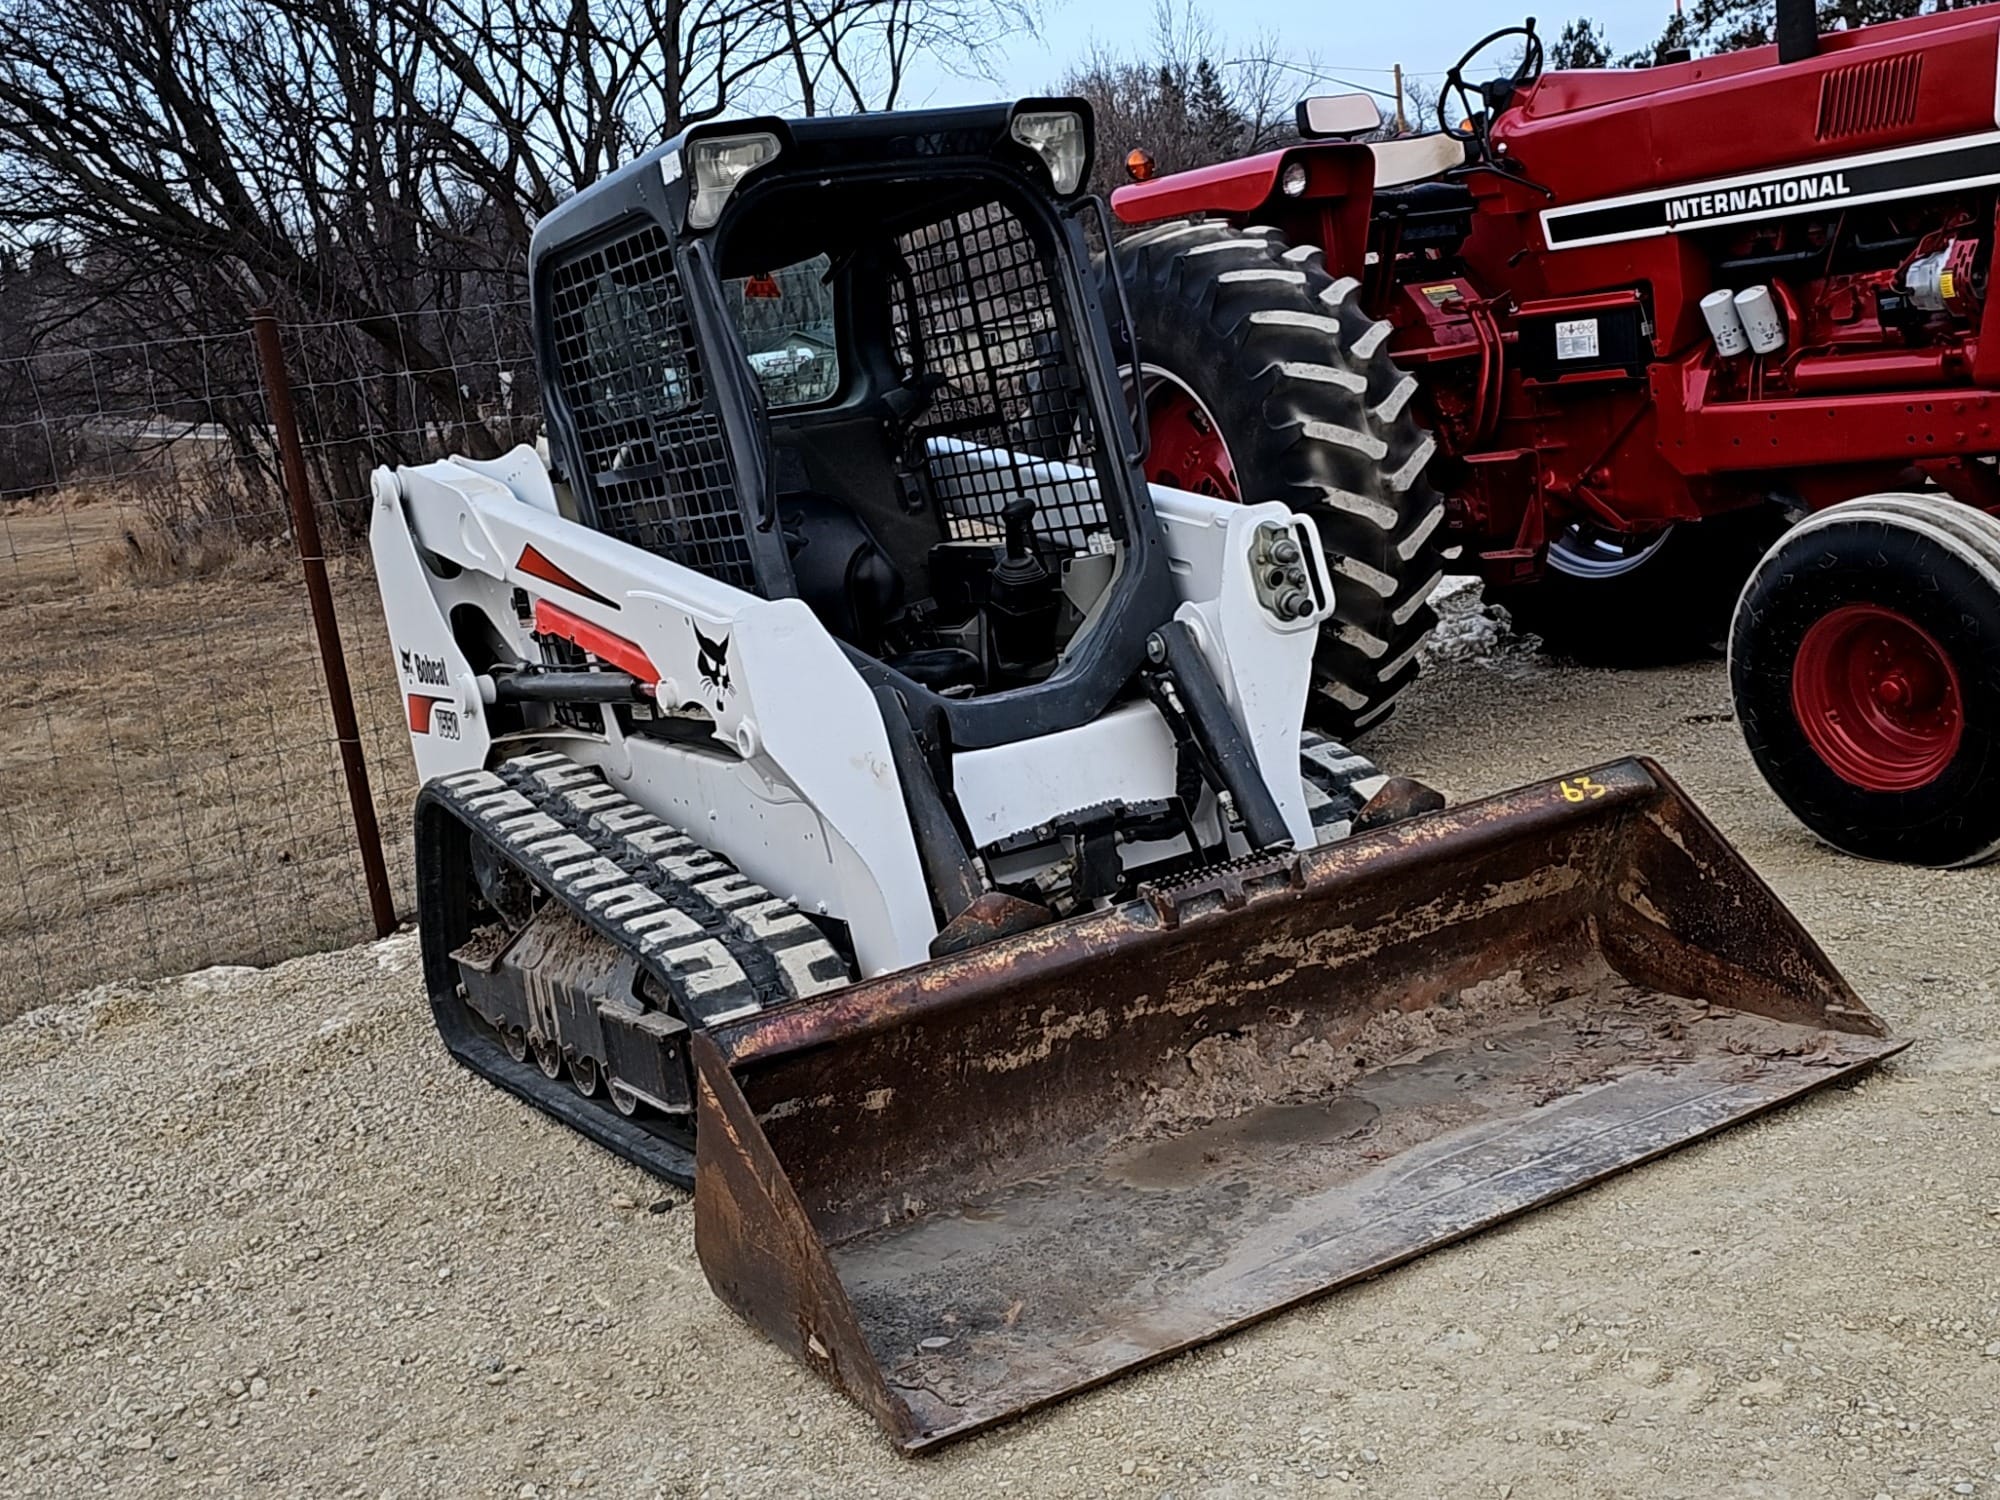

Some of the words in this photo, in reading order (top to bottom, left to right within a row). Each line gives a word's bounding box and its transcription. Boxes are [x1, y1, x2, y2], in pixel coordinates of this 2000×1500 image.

[1665, 173, 1850, 221] INTERNATIONAL
[414, 653, 449, 686] Bobcat
[435, 708, 460, 741] T550
[1560, 776, 1606, 803] 63
